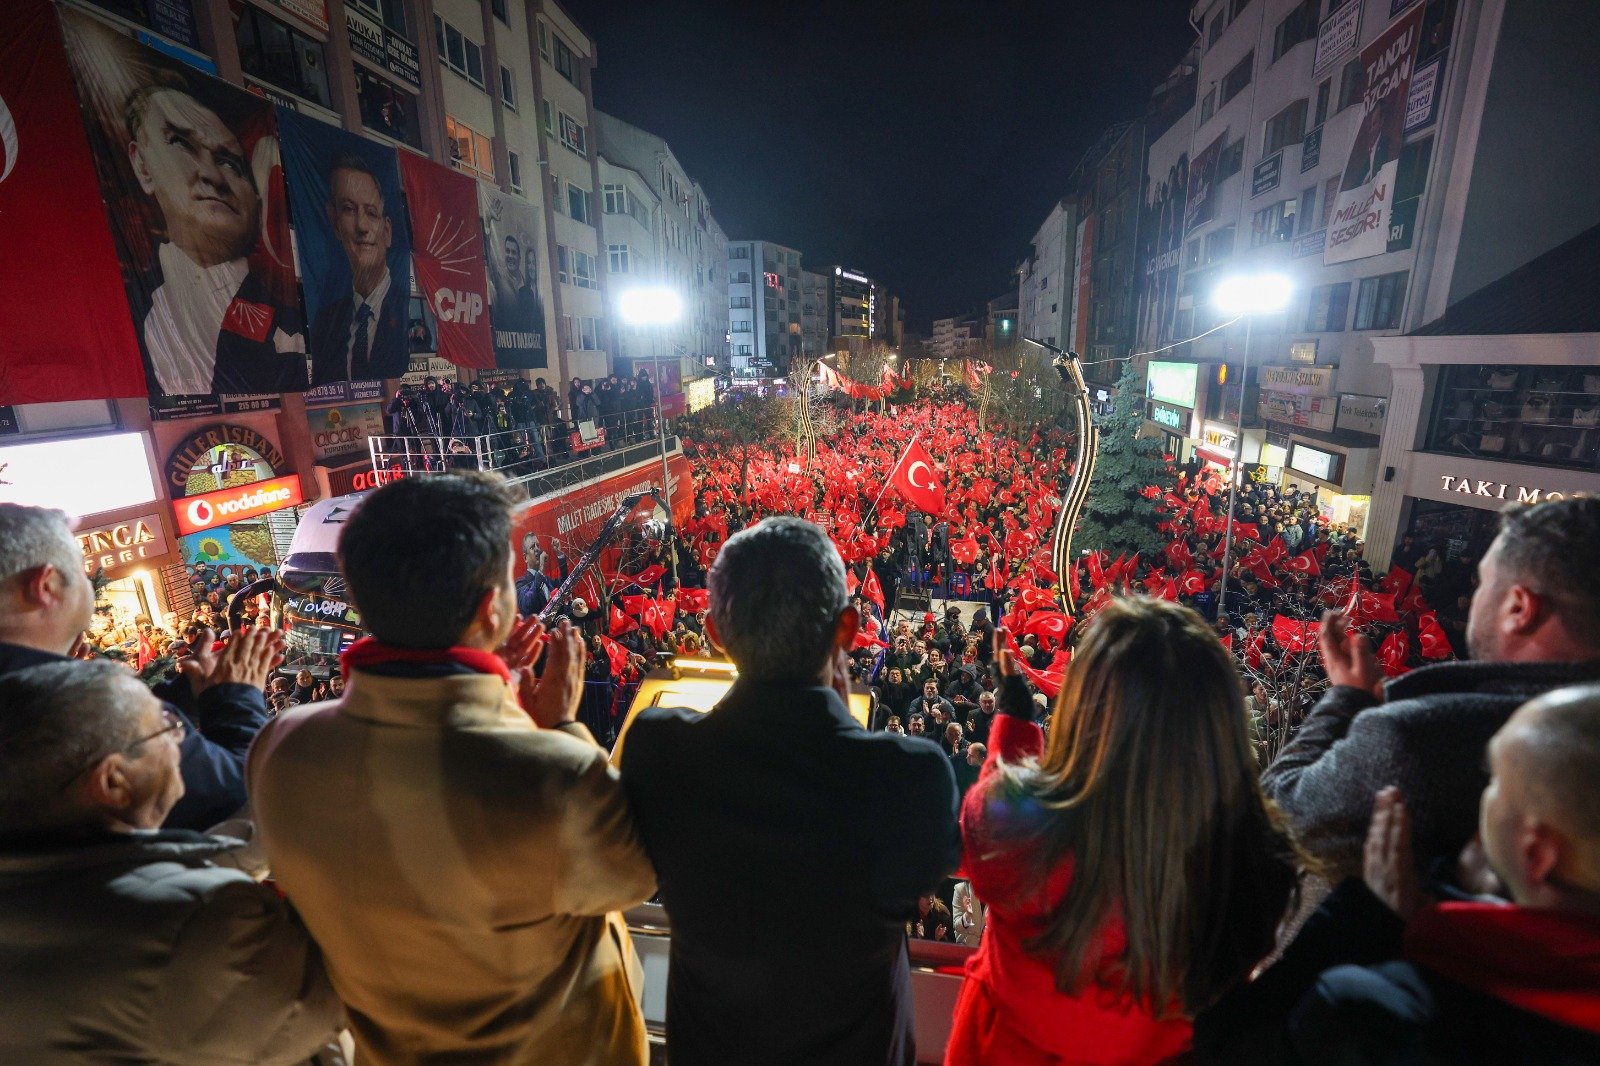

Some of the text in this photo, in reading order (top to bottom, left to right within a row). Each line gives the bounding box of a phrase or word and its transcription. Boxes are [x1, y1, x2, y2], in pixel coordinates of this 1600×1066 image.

[347, 15, 382, 46] AVUKAT
[1367, 25, 1414, 88] TANJU
[434, 287, 483, 324] CHP
[1341, 405, 1378, 419] Türk Telekom
[217, 487, 291, 515] vodafone
[1441, 475, 1508, 499] TAKI
